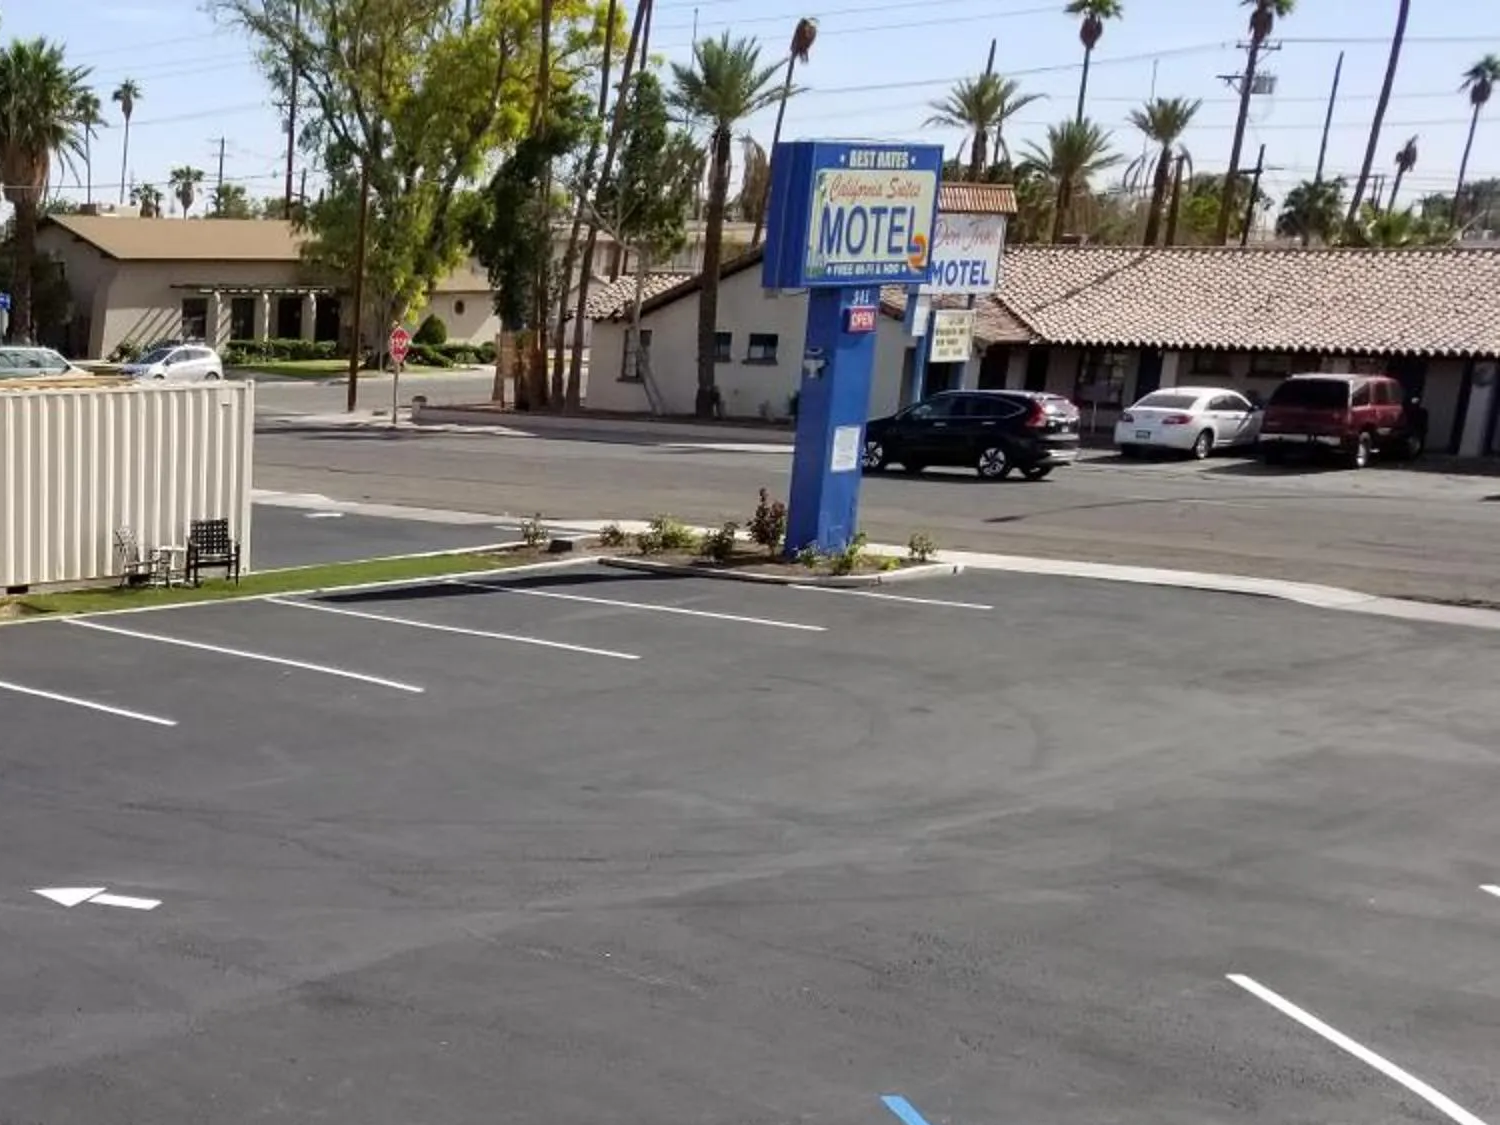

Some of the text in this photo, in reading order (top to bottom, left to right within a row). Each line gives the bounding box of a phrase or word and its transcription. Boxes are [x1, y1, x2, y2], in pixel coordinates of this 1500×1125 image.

[848, 150, 909, 168] BEST RATES
[819, 204, 920, 255] MOTEL
[930, 259, 990, 286] MOTEL
[851, 311, 875, 329] OPEN
